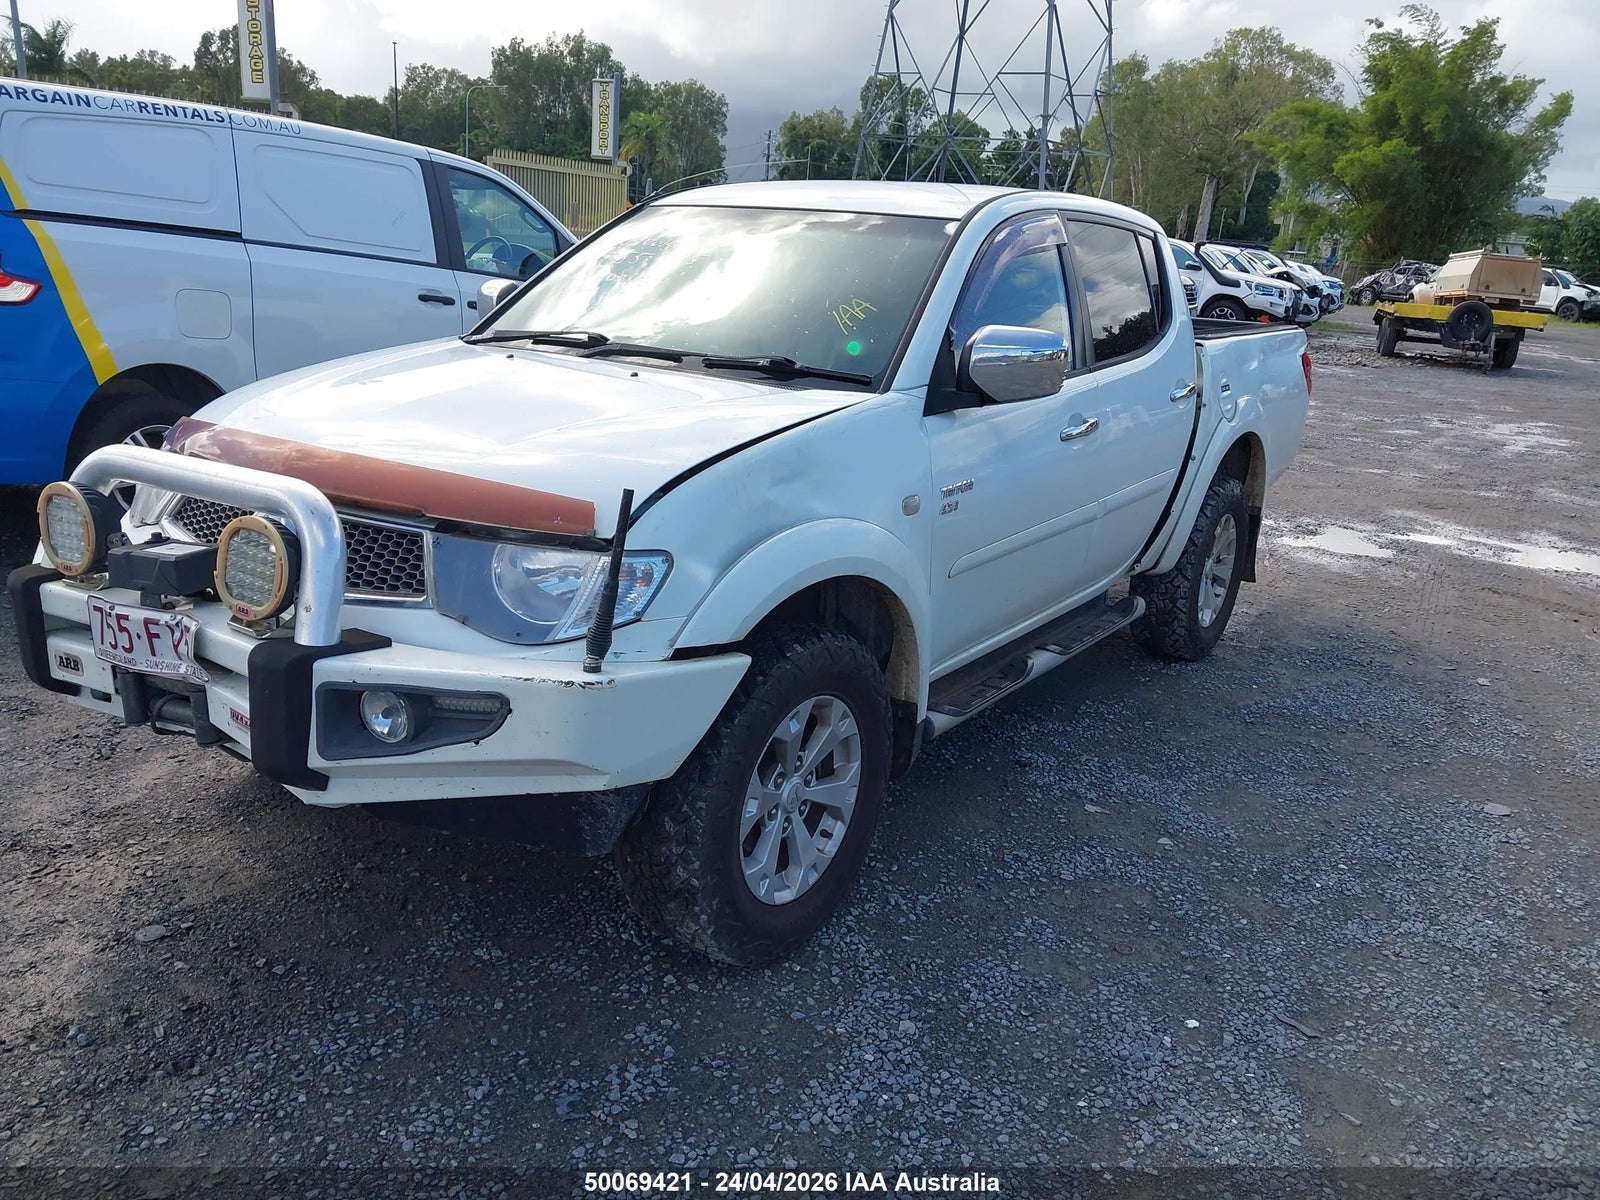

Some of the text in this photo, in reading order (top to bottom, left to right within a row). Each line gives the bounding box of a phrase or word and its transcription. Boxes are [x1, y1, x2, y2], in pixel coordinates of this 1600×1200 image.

[599, 82, 609, 155] TRANSPORT
[832, 298, 878, 336] IAA
[58, 655, 80, 672] ARB
[144, 658, 183, 673] SUNSHINE
